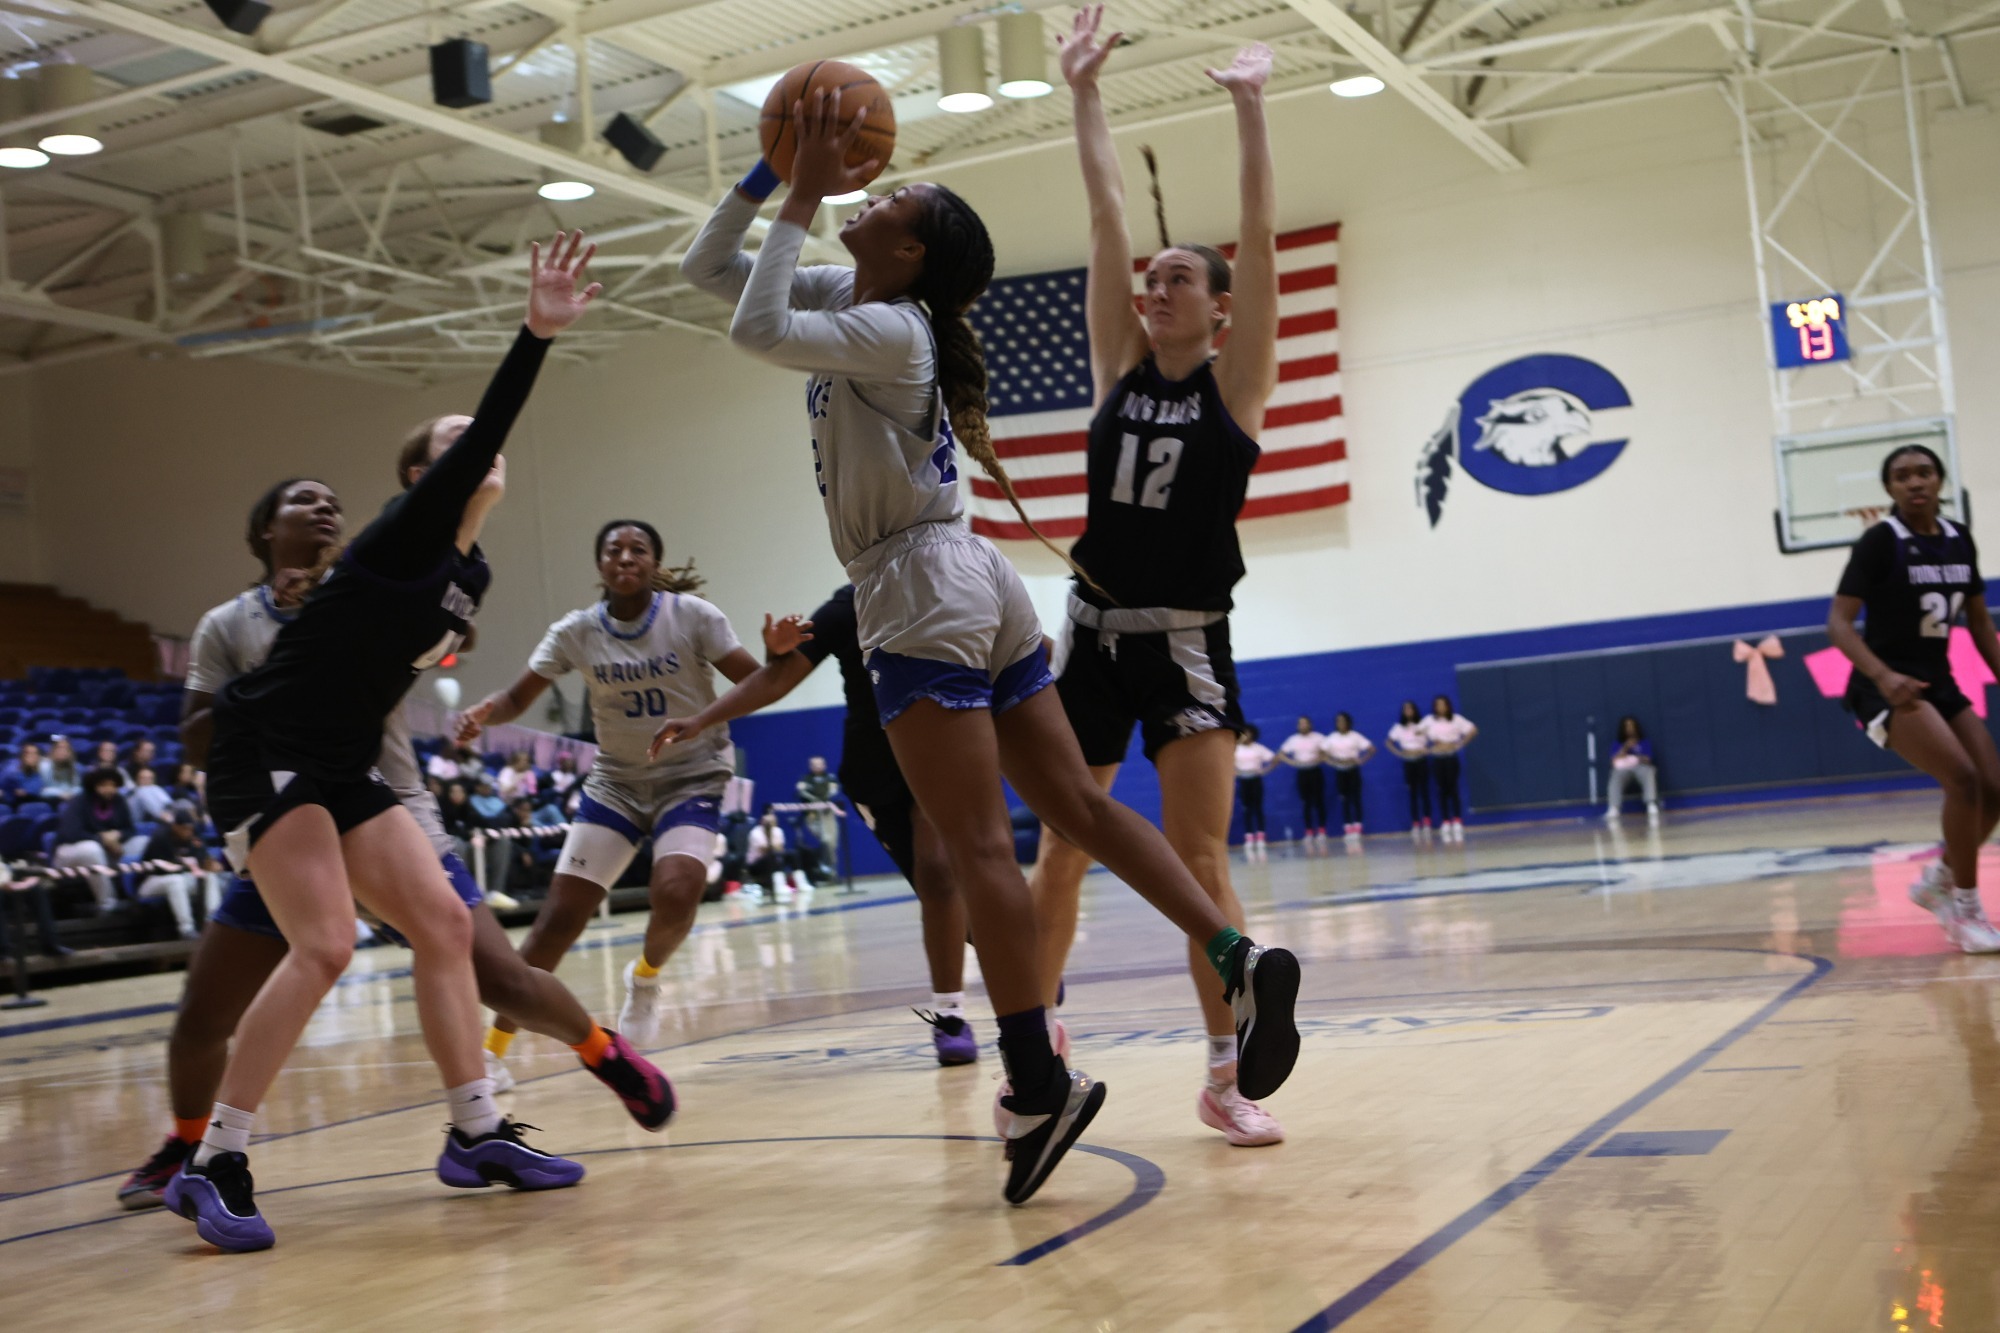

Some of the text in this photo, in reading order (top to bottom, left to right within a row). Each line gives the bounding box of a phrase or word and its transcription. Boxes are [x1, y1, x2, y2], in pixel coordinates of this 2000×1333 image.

[1800, 321, 1834, 360] 13
[1110, 431, 1184, 511] 12
[593, 652, 681, 686] HAWKS
[621, 687, 666, 718] 30
